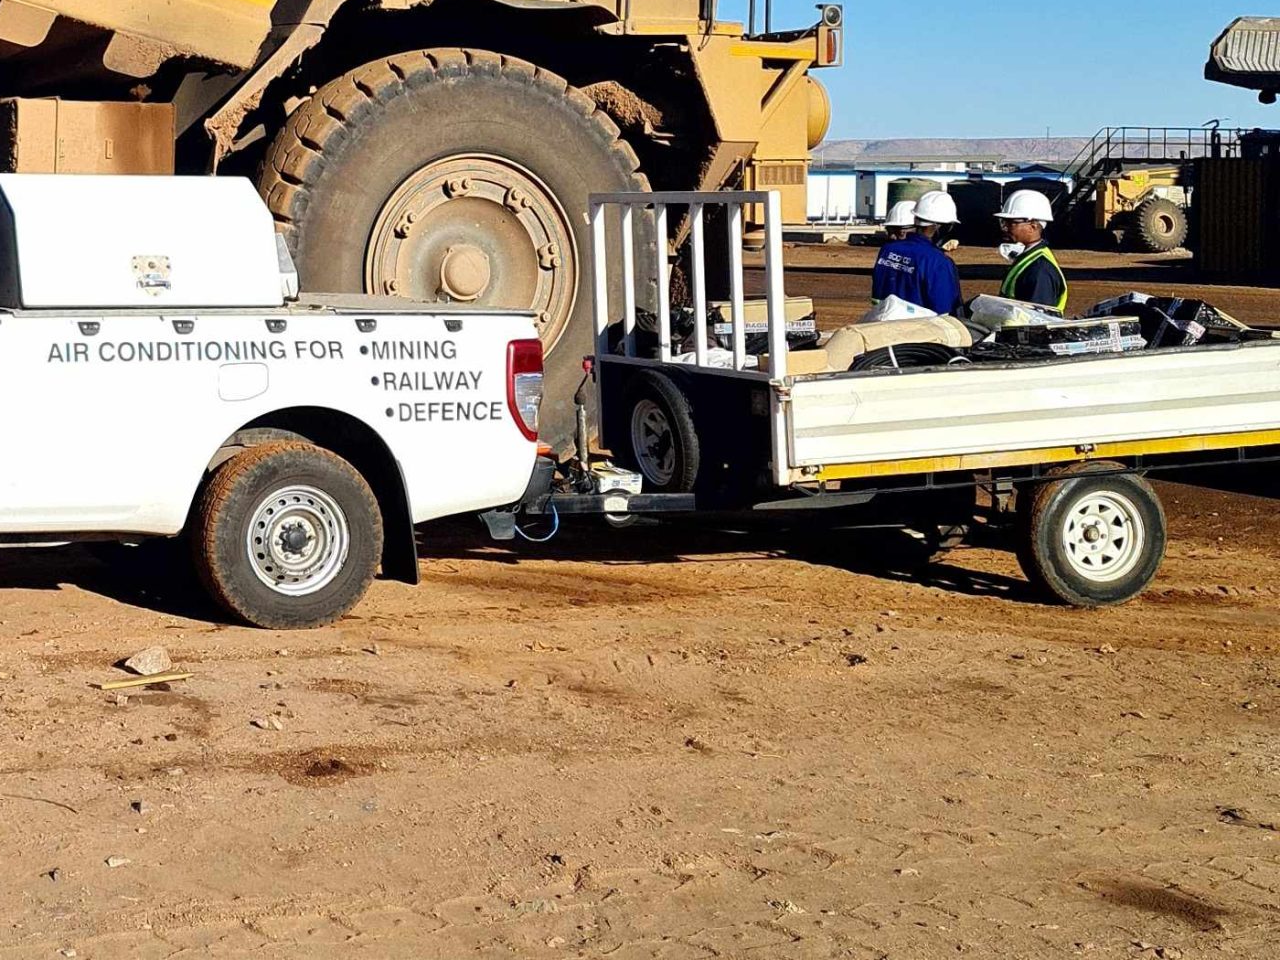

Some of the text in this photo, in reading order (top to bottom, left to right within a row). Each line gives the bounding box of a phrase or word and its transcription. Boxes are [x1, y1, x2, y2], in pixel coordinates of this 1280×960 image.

[47, 342, 89, 363] AIR
[98, 340, 287, 362] CONDITIONING
[295, 340, 344, 360] FOR
[383, 371, 483, 391] RAILWAY
[398, 401, 503, 422] DEFENCE
